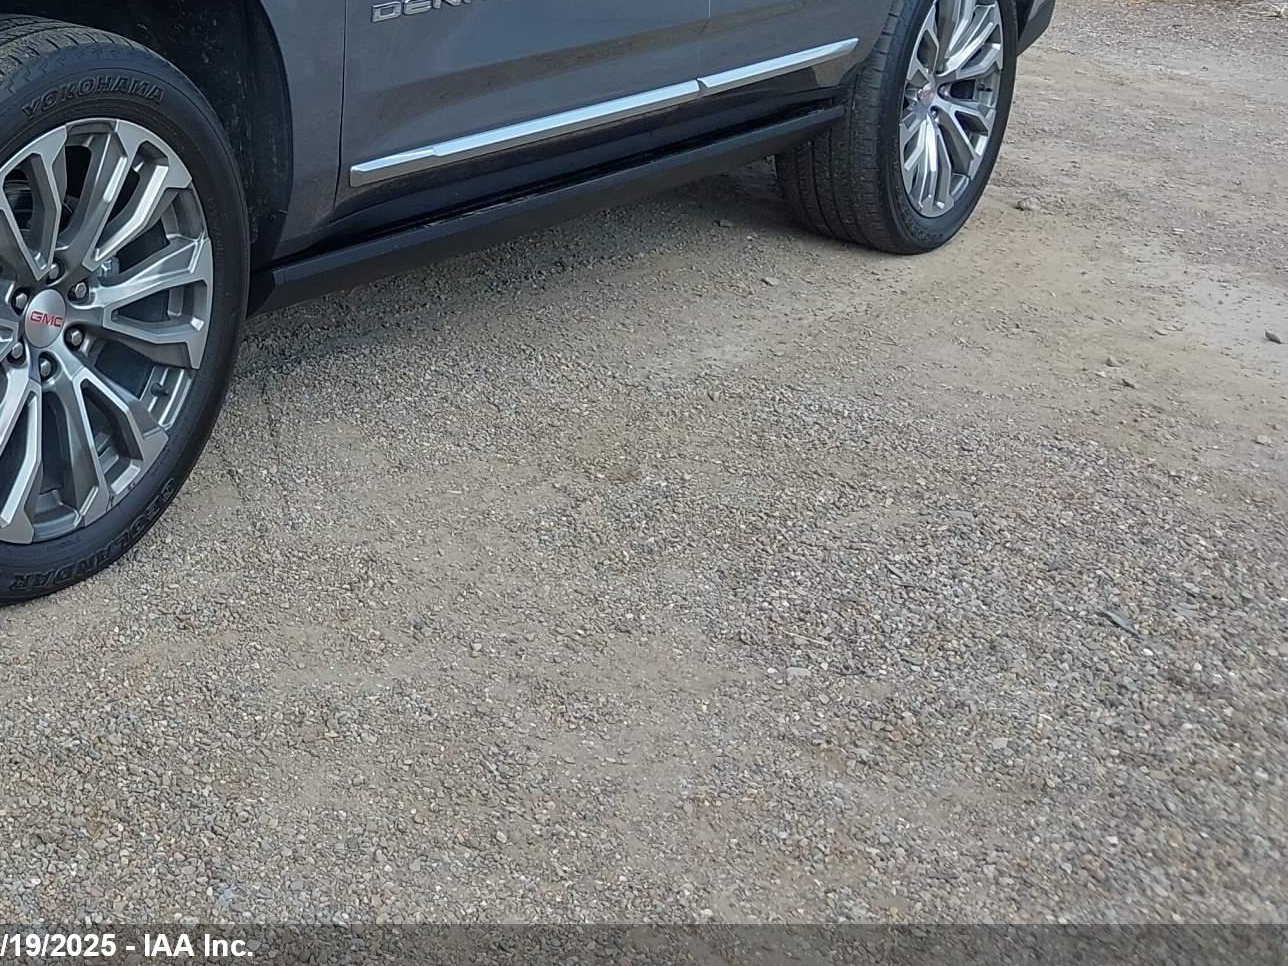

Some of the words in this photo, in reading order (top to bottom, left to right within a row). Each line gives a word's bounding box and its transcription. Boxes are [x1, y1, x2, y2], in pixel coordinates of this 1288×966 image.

[22, 75, 165, 120] YOKOHAMA
[30, 310, 63, 328] GMC
[9, 477, 176, 592] GEOLANDAR
